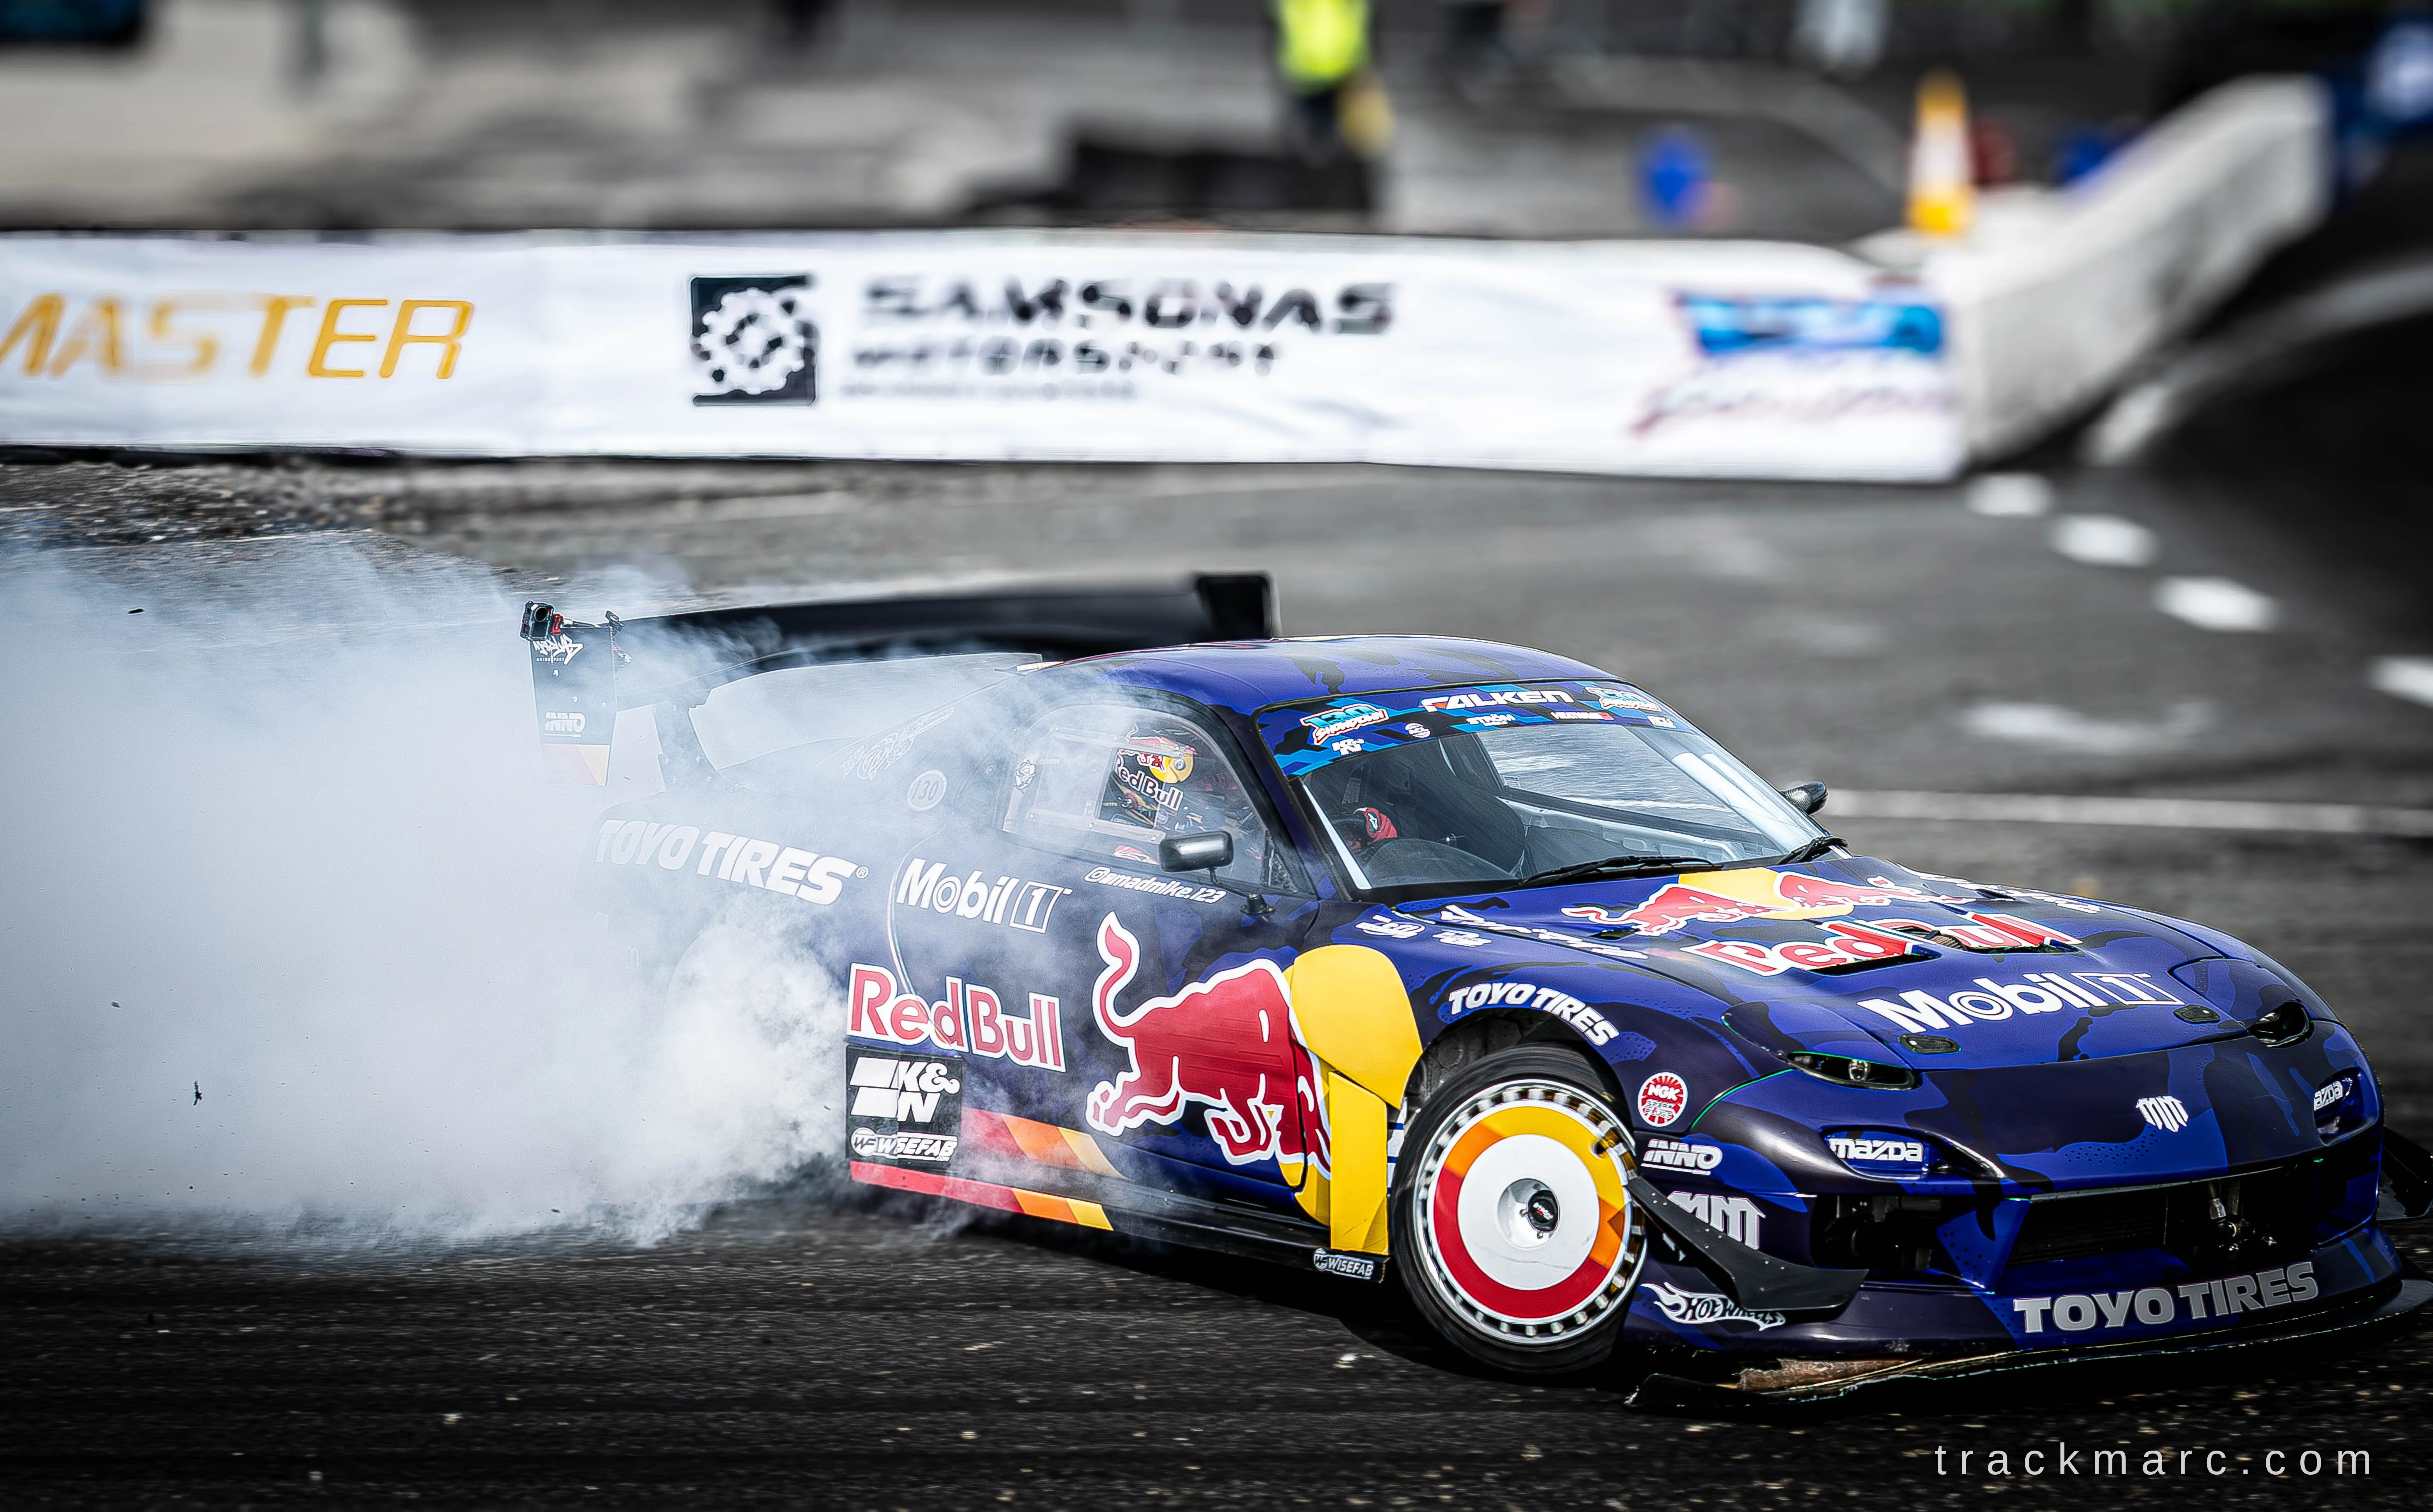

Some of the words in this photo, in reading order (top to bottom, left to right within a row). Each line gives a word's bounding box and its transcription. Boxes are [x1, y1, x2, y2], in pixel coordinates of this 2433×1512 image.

[1421, 691, 1575, 712] FALKEN
[911, 780, 939, 801] 130
[1141, 776, 1183, 811] Bull
[595, 819, 700, 870] TOYO
[896, 858, 1020, 925] Mobil
[848, 964, 967, 1051] Red
[967, 984, 1065, 1071] Bull
[1449, 982, 1536, 1015] TOYO
[1531, 987, 1619, 1047] TIRES
[1856, 972, 2109, 1034] Mobil
[1647, 1084, 1680, 1101] NGK
[2314, 1081, 2343, 1111] azda
[1329, 1257, 1374, 1276] WISEFAB
[2013, 1286, 2175, 1334] TOYO
[2177, 1261, 2319, 1320] TIRES
